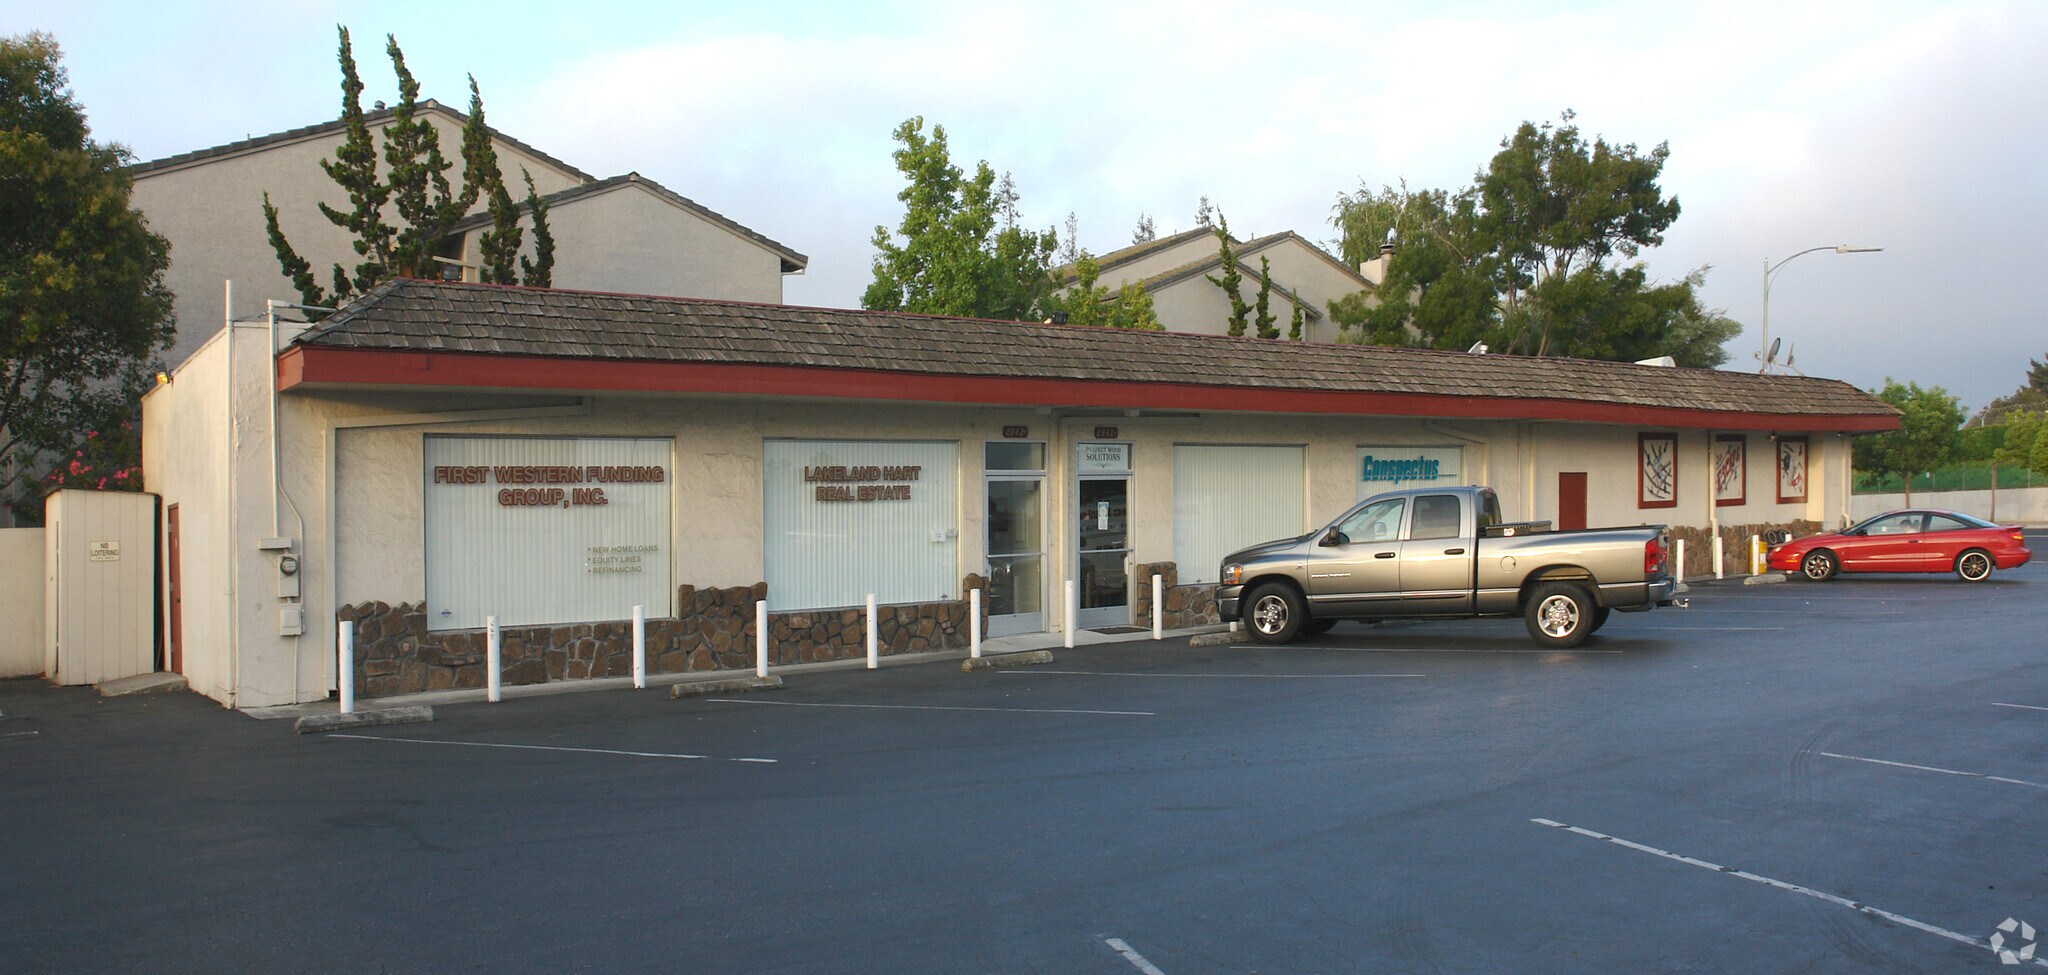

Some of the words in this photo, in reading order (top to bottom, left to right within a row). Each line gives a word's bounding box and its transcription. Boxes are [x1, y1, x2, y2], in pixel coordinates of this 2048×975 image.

[1086, 453, 1121, 461] SOLUTIONS
[434, 466, 489, 483] FIRST
[494, 466, 583, 483] WESTERN
[586, 466, 664, 482] FUNDING
[804, 465, 880, 481] LAKELAND
[883, 465, 921, 480] HART
[1363, 455, 1439, 484] Conspectus
[498, 488, 569, 508] GROUP,
[572, 488, 608, 504] INC.
[816, 486, 855, 501] REAL
[857, 485, 911, 500] ESTATE
[611, 545, 633, 553] HOME
[592, 556, 619, 564] EQUITY
[620, 555, 641, 563] LINES
[592, 565, 642, 574] REFINANCING
